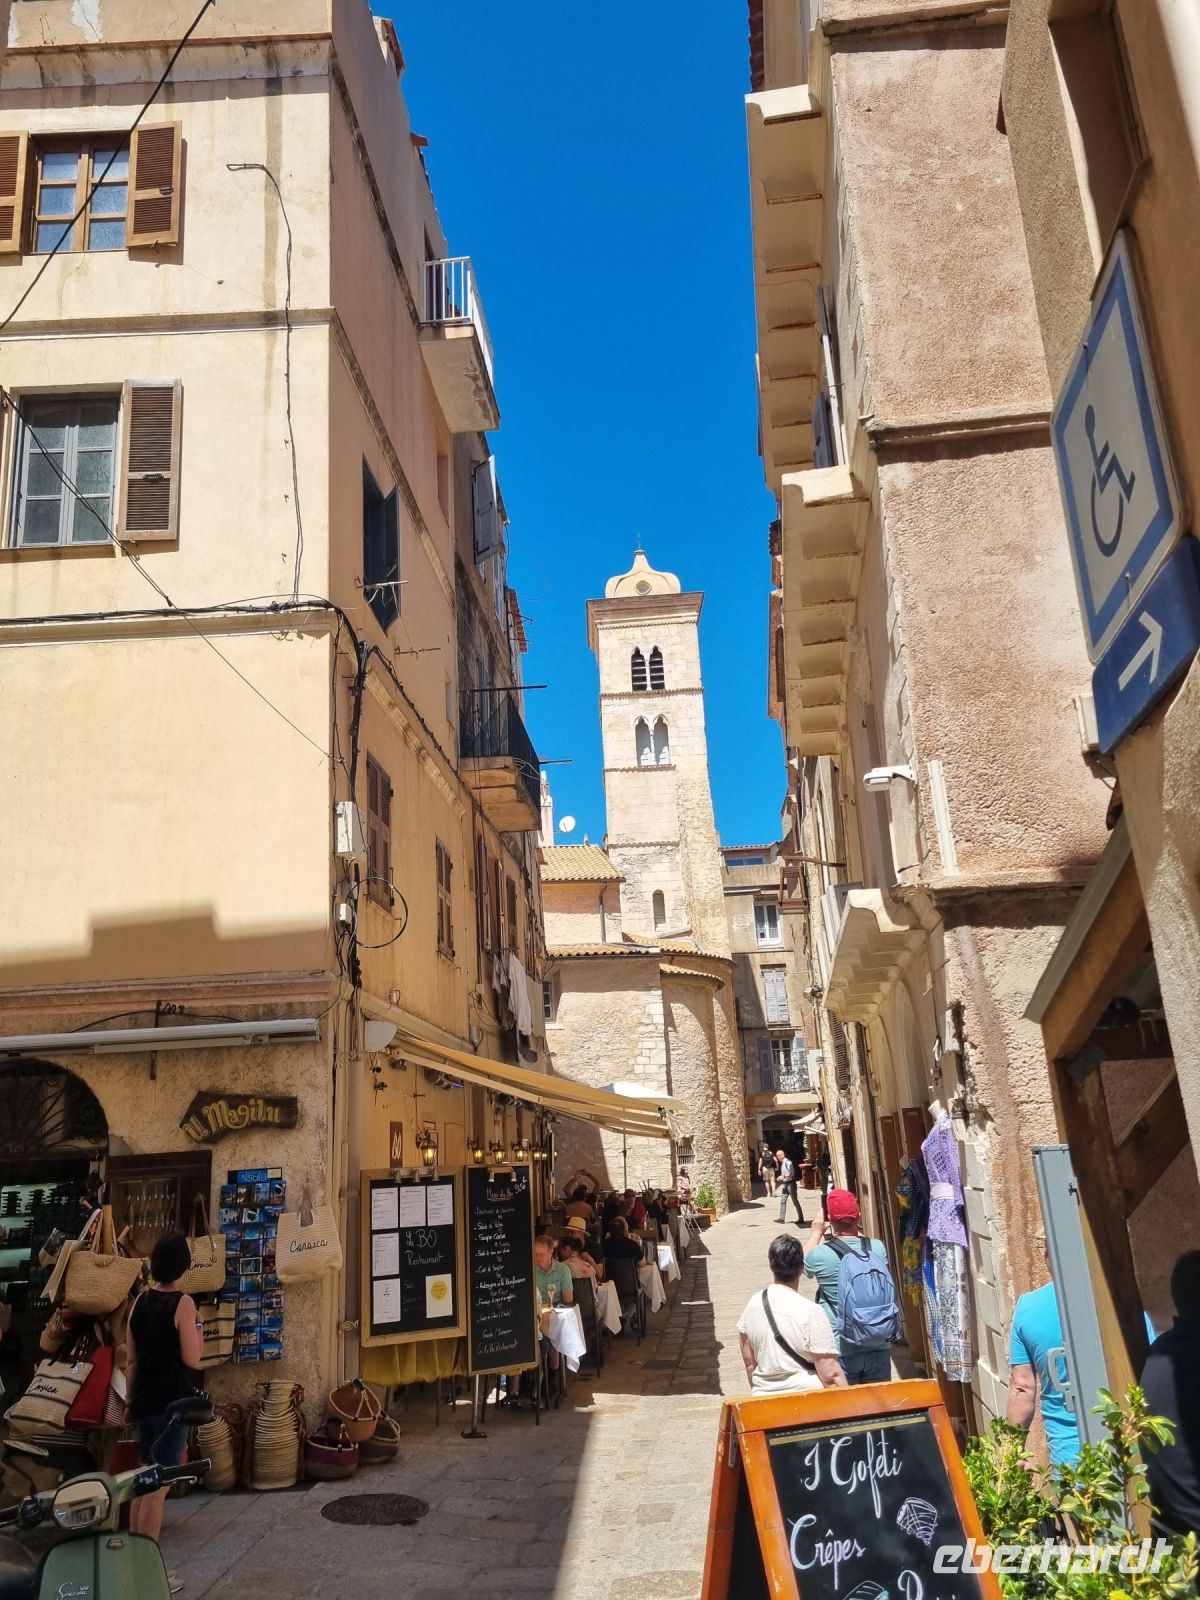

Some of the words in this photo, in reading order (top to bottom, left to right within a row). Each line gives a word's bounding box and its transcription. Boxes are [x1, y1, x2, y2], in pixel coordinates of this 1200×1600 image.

[202, 1098, 281, 1134] Magilu
[289, 1239, 329, 1254] Corsica
[414, 1228, 438, 1248] BO
[27, 1378, 59, 1394] Corsica
[787, 1513, 867, 1591] Crêpes
